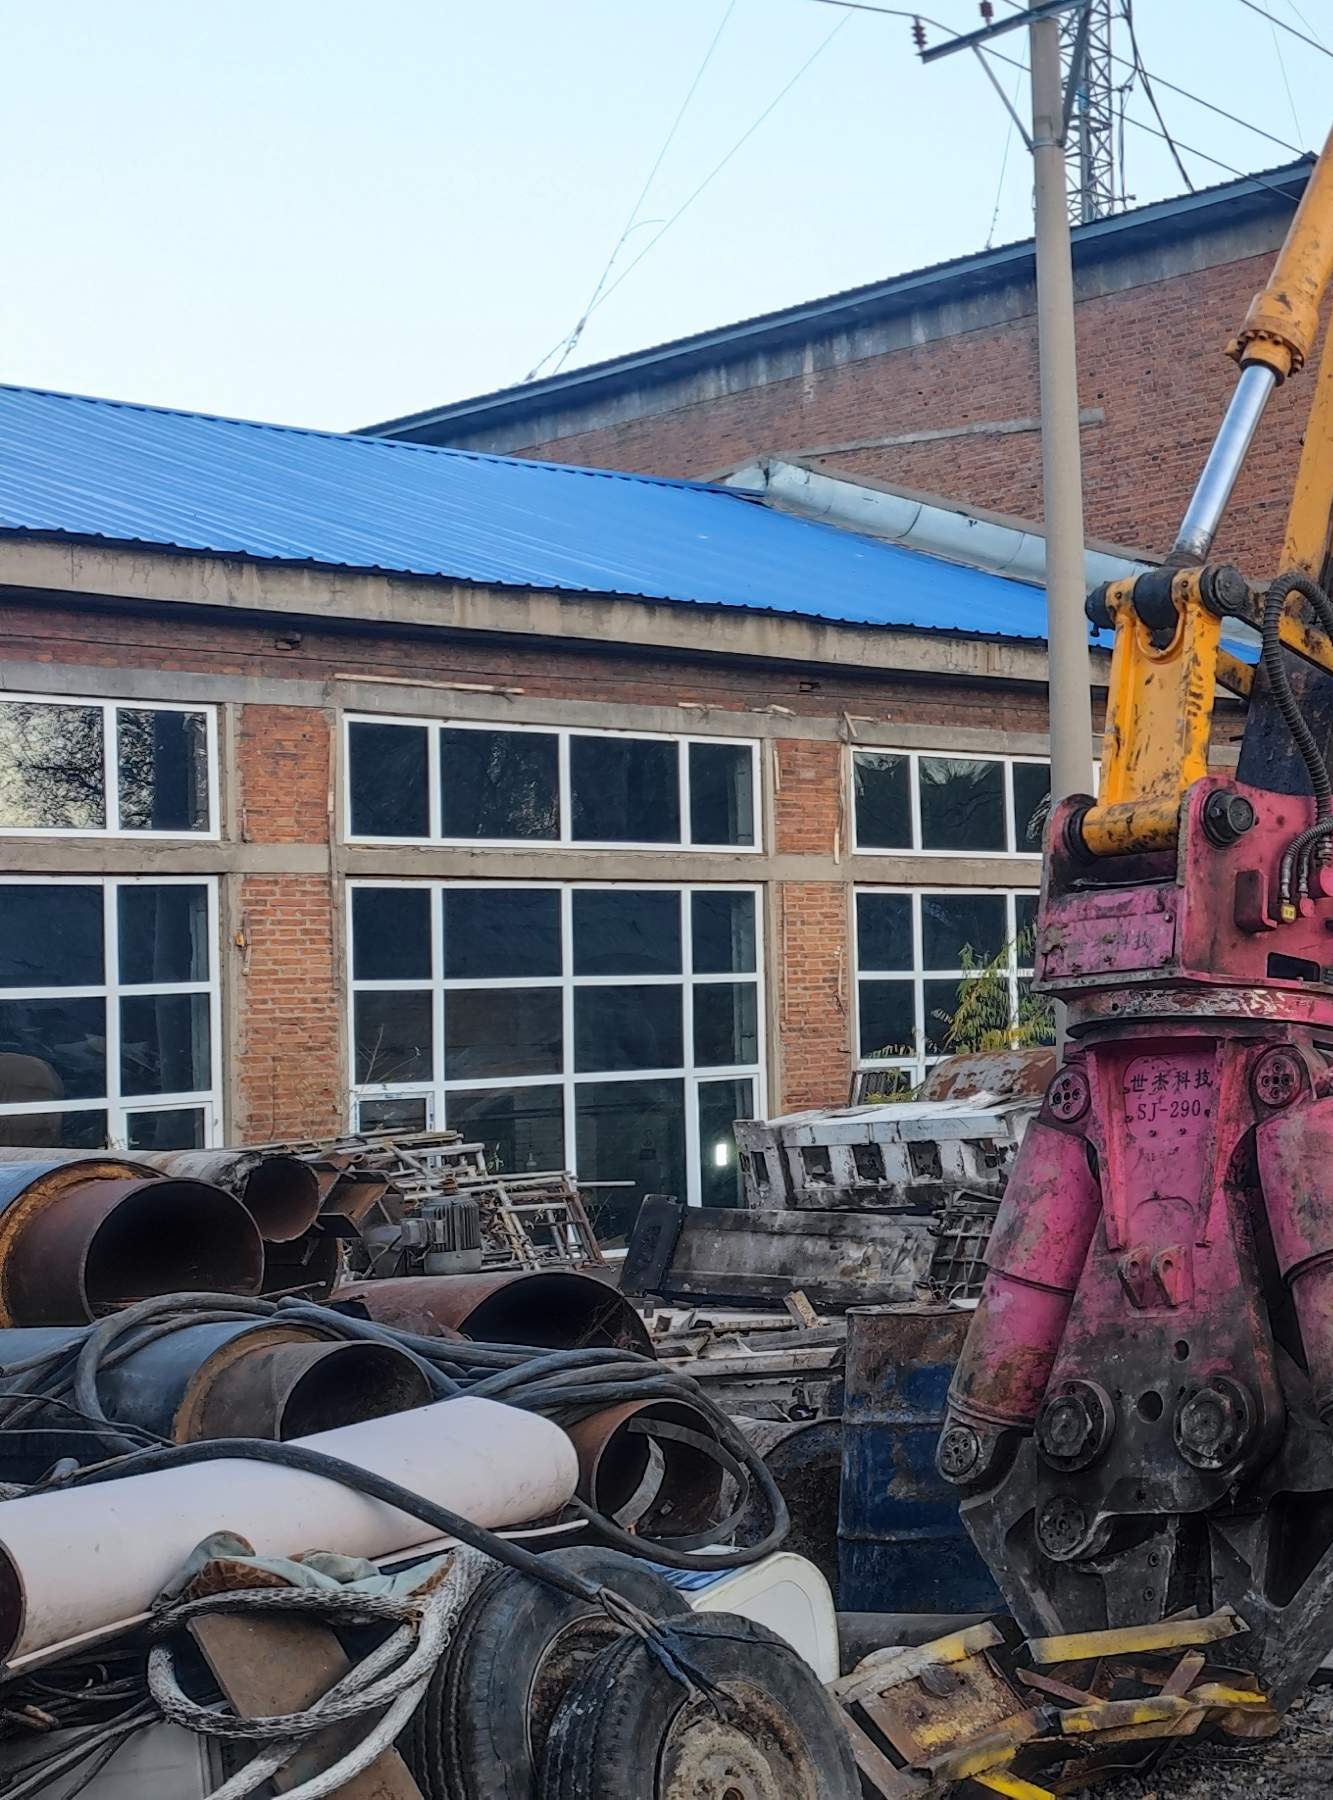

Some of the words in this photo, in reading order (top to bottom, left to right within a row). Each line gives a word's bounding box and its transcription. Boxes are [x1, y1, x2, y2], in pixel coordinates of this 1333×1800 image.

[1130, 1067, 1213, 1094] 世杰科技
[1137, 1099, 1201, 1122] SJ-290
